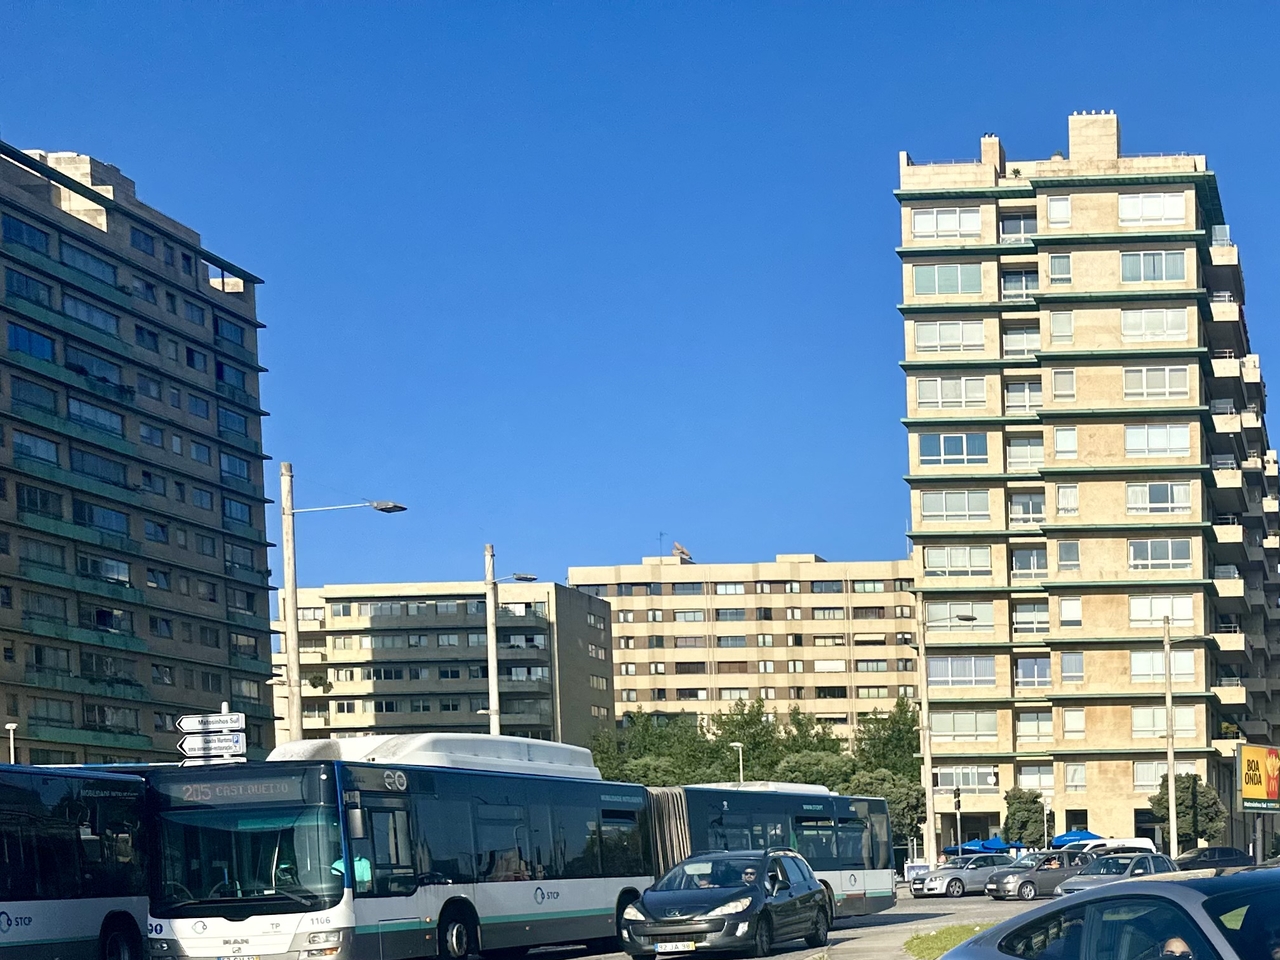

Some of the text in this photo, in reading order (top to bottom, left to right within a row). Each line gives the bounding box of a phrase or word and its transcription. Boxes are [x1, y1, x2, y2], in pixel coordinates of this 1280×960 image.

[198, 718, 229, 726] Matosinhos
[1246, 759, 1260, 772] BOA
[1244, 772, 1262, 786] ONDA
[182, 784, 212, 801] 205
[546, 891, 560, 900] STCP
[14, 916, 33, 926] STCP
[310, 916, 331, 925] 1106
[270, 922, 281, 930] TP
